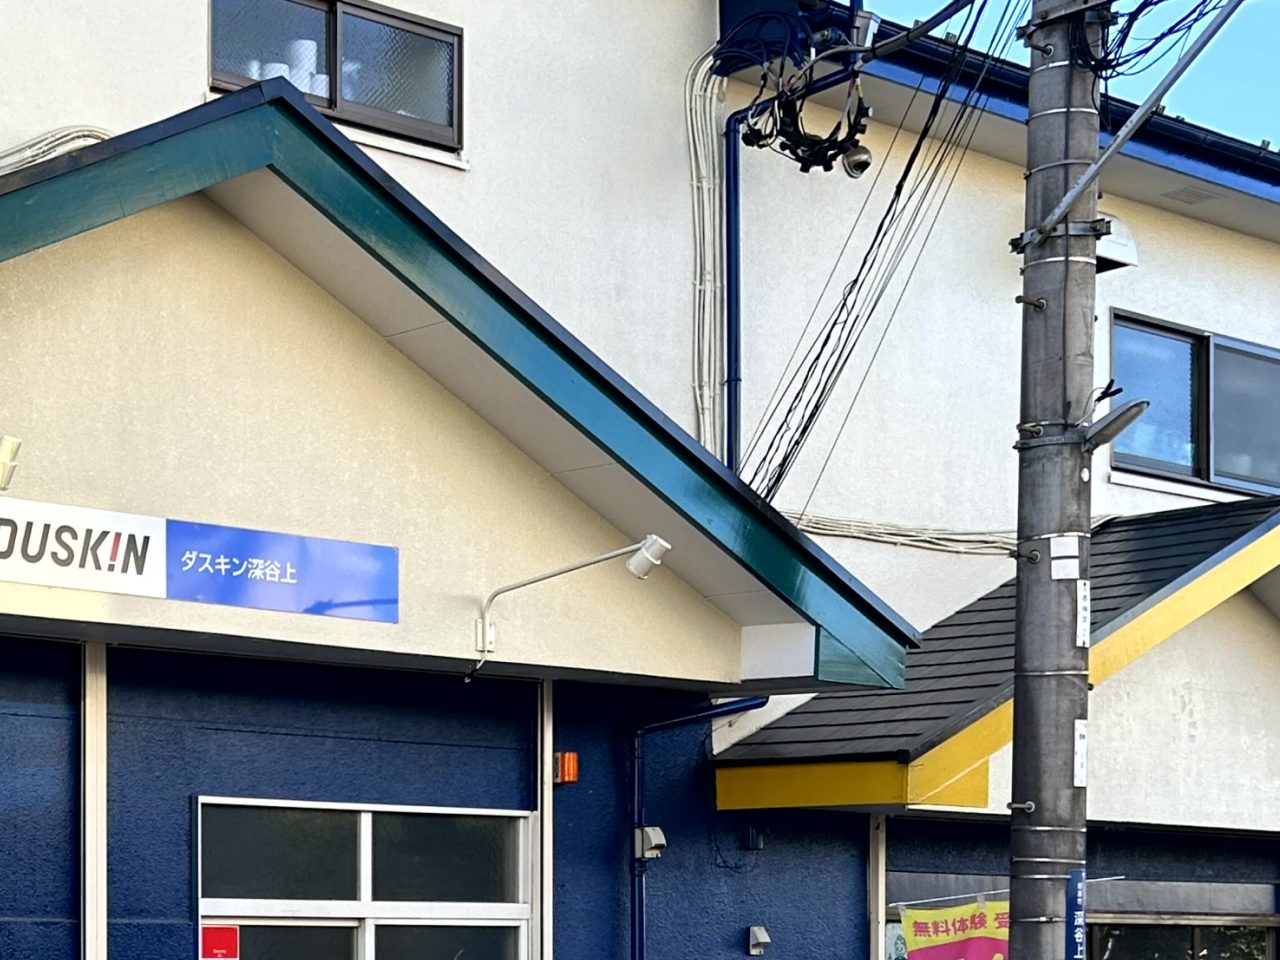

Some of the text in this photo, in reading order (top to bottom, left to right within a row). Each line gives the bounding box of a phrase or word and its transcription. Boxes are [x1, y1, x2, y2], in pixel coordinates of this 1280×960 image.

[181, 551, 298, 583] ダスキン深谷上
[912, 912, 987, 937] 無料体験
